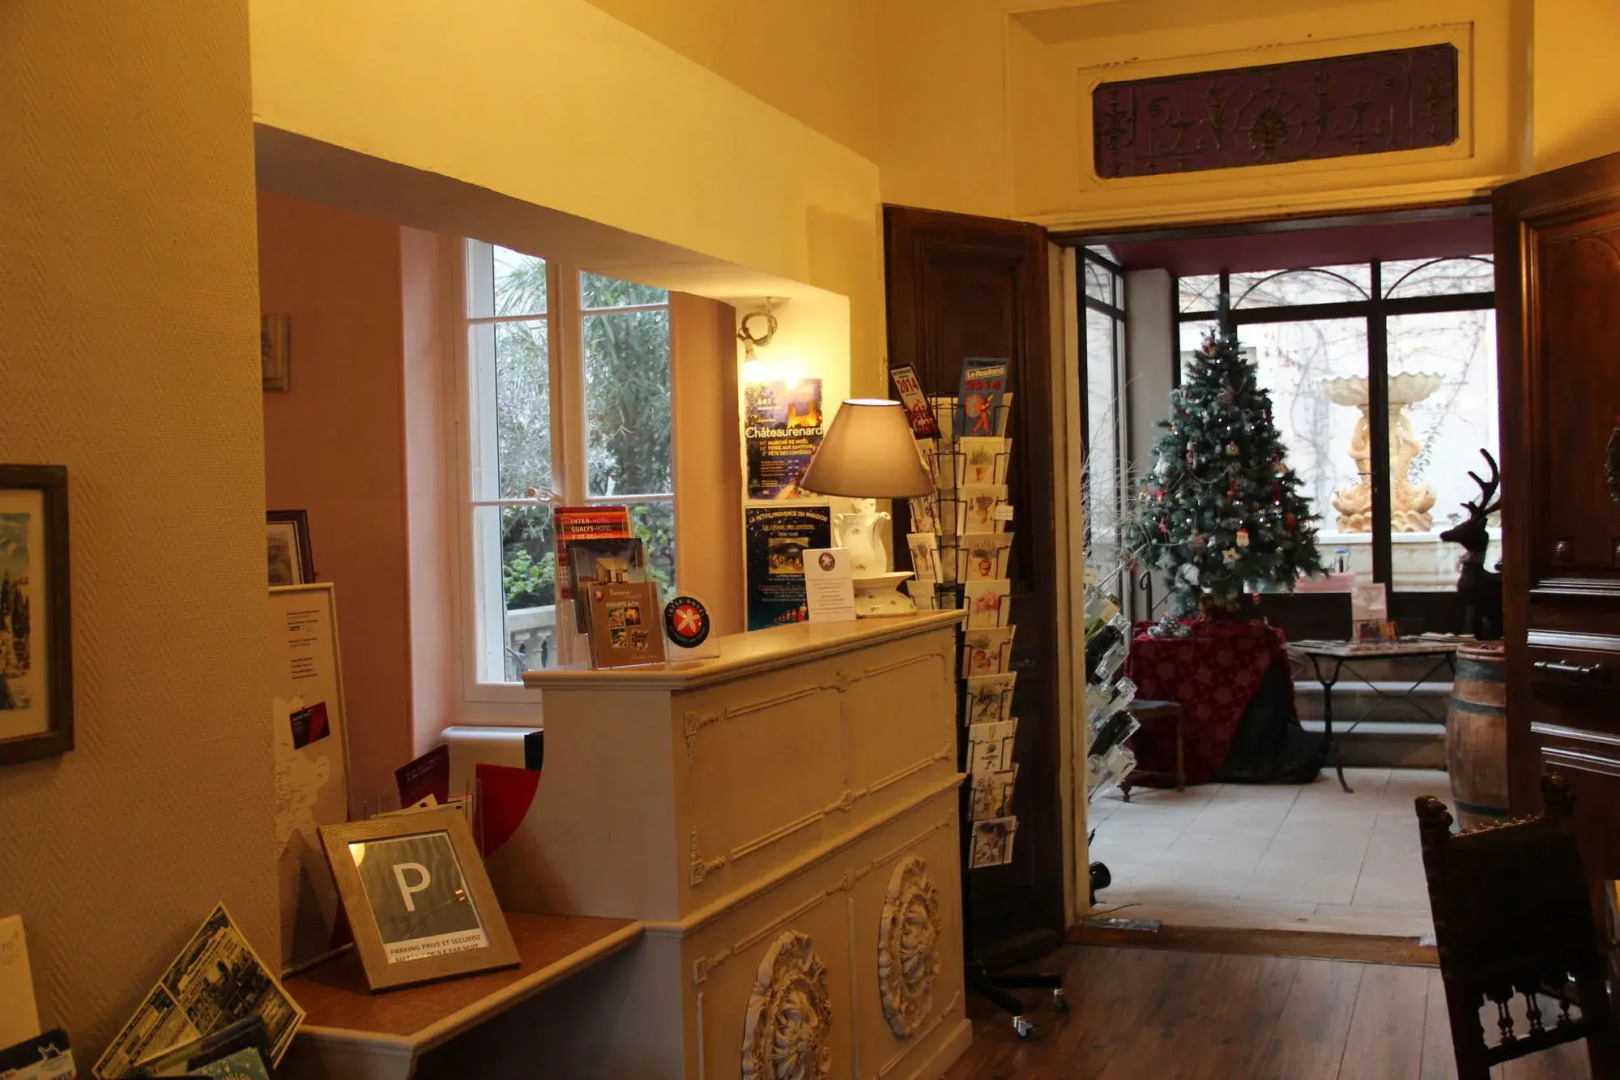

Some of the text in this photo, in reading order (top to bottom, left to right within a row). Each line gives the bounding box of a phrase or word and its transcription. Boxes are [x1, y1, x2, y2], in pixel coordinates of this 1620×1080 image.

[897, 377, 919, 394] 2014
[966, 379, 1002, 391] 2014
[745, 425, 823, 438] Châteaurenard
[393, 862, 431, 912] P
[390, 945, 421, 955] PARKING
[422, 941, 441, 949] PRIVE
[451, 934, 481, 944] SECURISE
